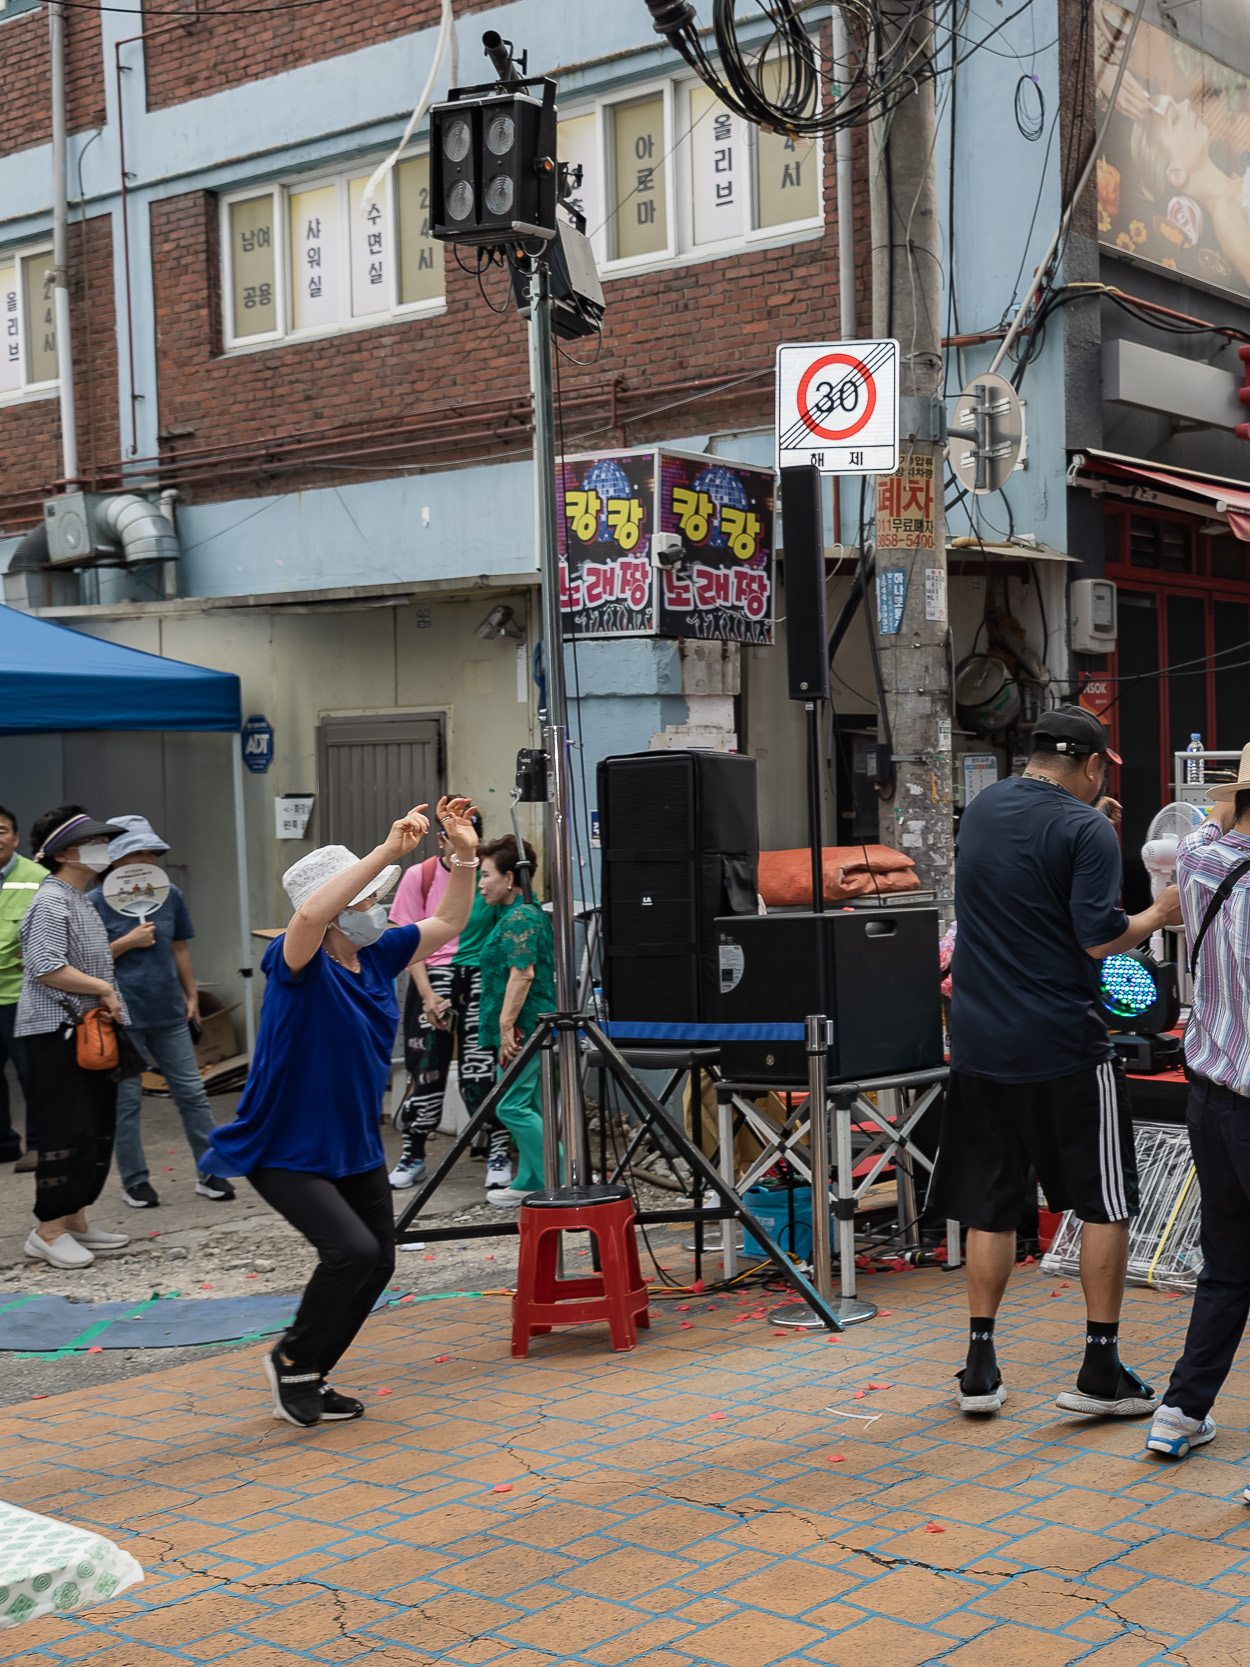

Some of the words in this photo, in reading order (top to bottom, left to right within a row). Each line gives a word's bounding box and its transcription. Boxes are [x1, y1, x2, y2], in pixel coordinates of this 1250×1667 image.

[635, 134, 655, 226] 아로마
[713, 113, 735, 208] 올리브
[241, 226, 271, 253] 남여
[305, 217, 323, 298] 샤워실
[366, 203, 384, 285] 수면실
[242, 283, 272, 310] 공용
[6, 292, 20, 362] 올리브
[815, 380, 859, 414] 30
[877, 478, 934, 520] 폐차
[245, 734, 270, 755] ADT
